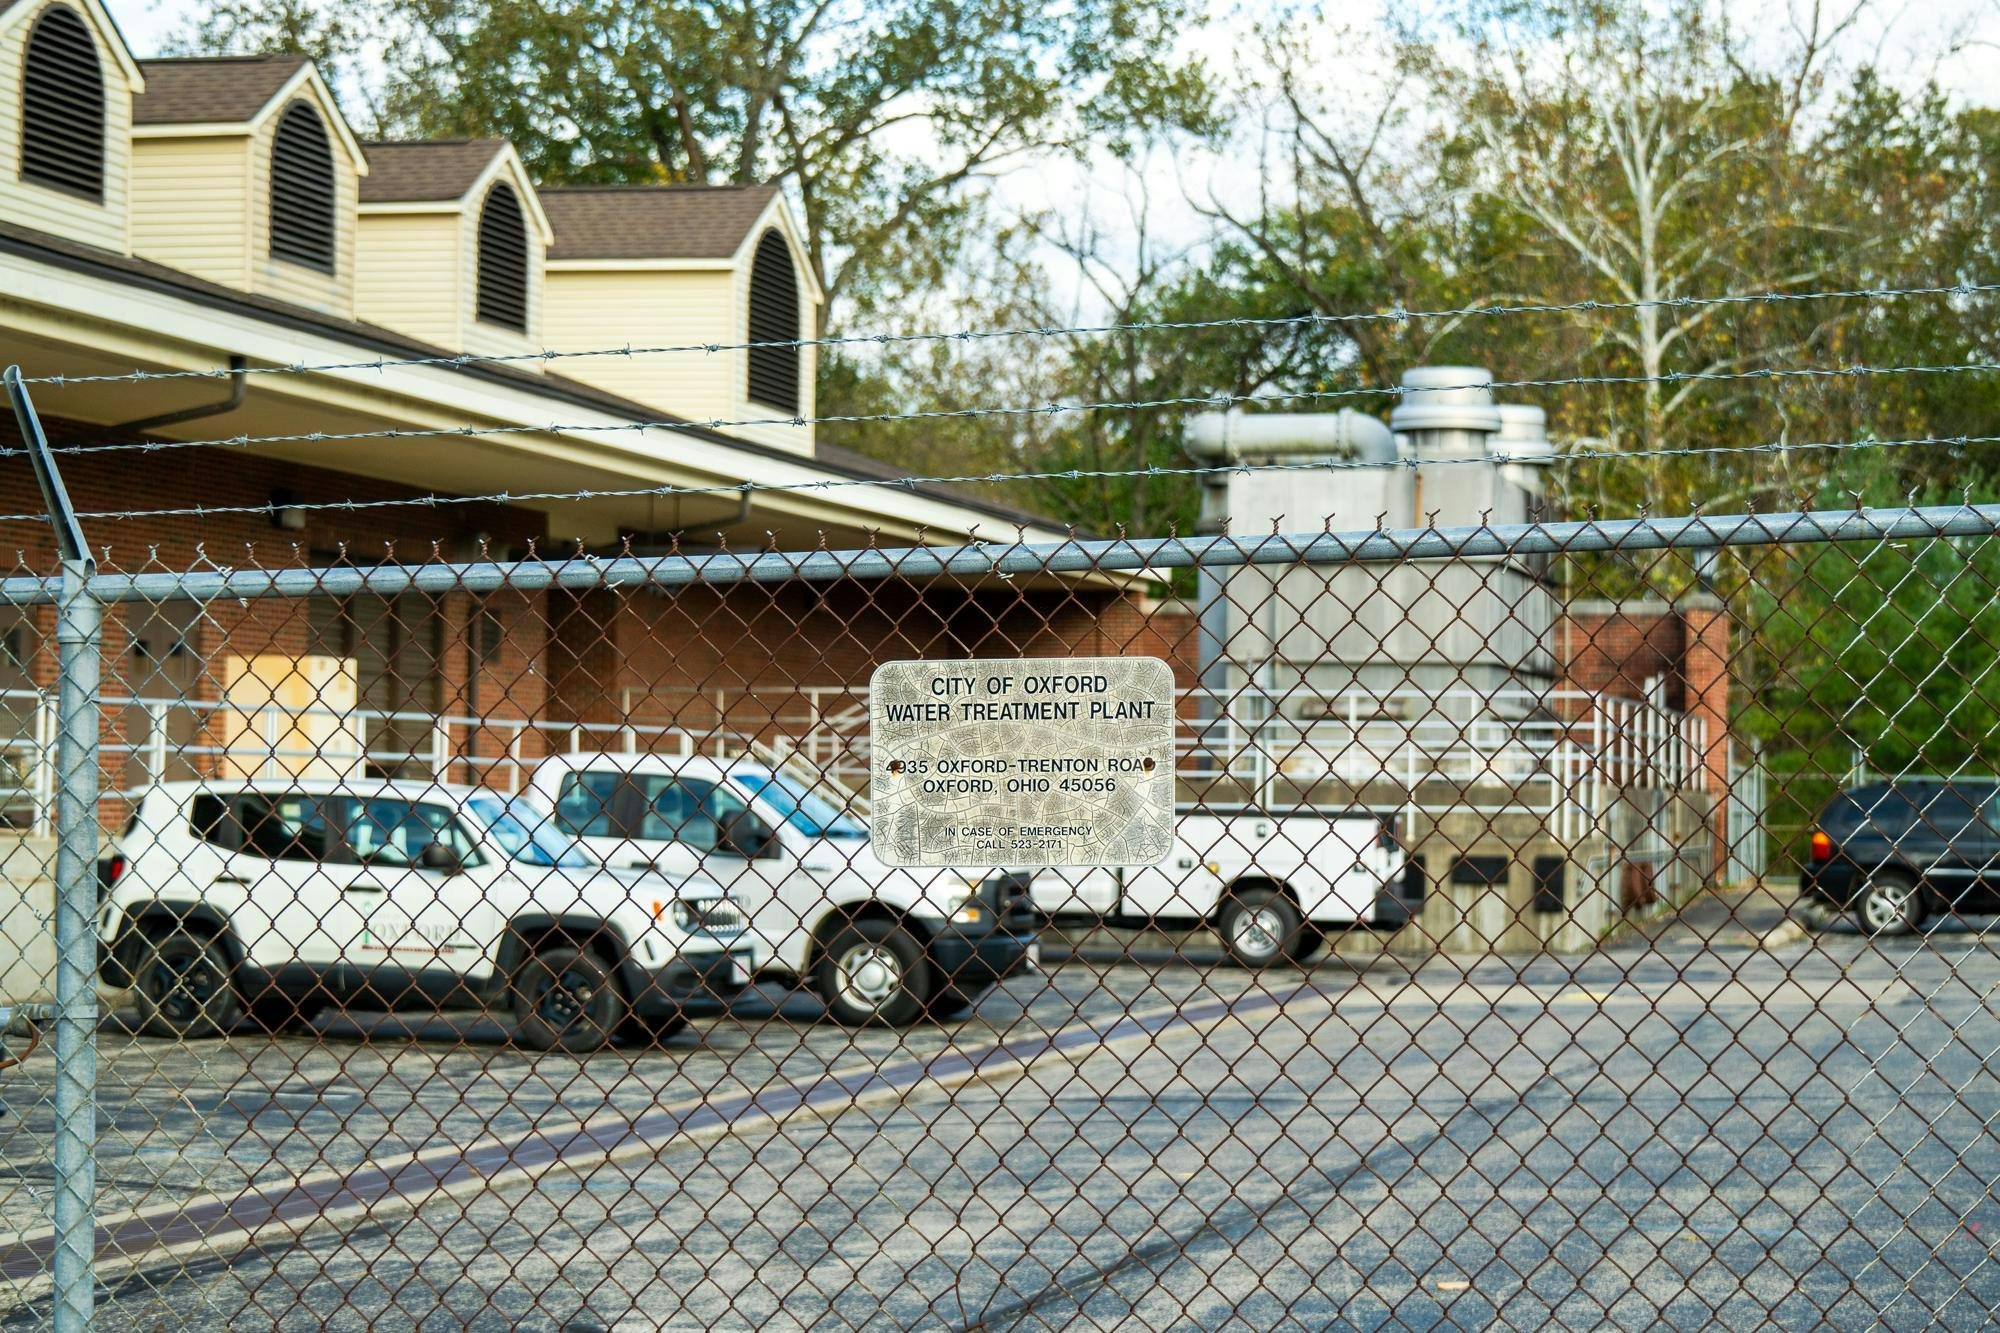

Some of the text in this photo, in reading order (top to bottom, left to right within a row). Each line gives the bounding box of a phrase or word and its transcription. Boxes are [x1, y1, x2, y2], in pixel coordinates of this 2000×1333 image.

[931, 675, 1108, 696] CITY OF OXFORD
[886, 701, 1155, 722] WATER TREATMENT PLANT
[937, 758, 1098, 773] OXFORD-TRENTON
[923, 778, 1116, 795] OXFORD, OHIO 45056
[944, 826, 1092, 837] IN CASE OF EMERGENCY
[976, 839, 1062, 849] CALL 523-2171
